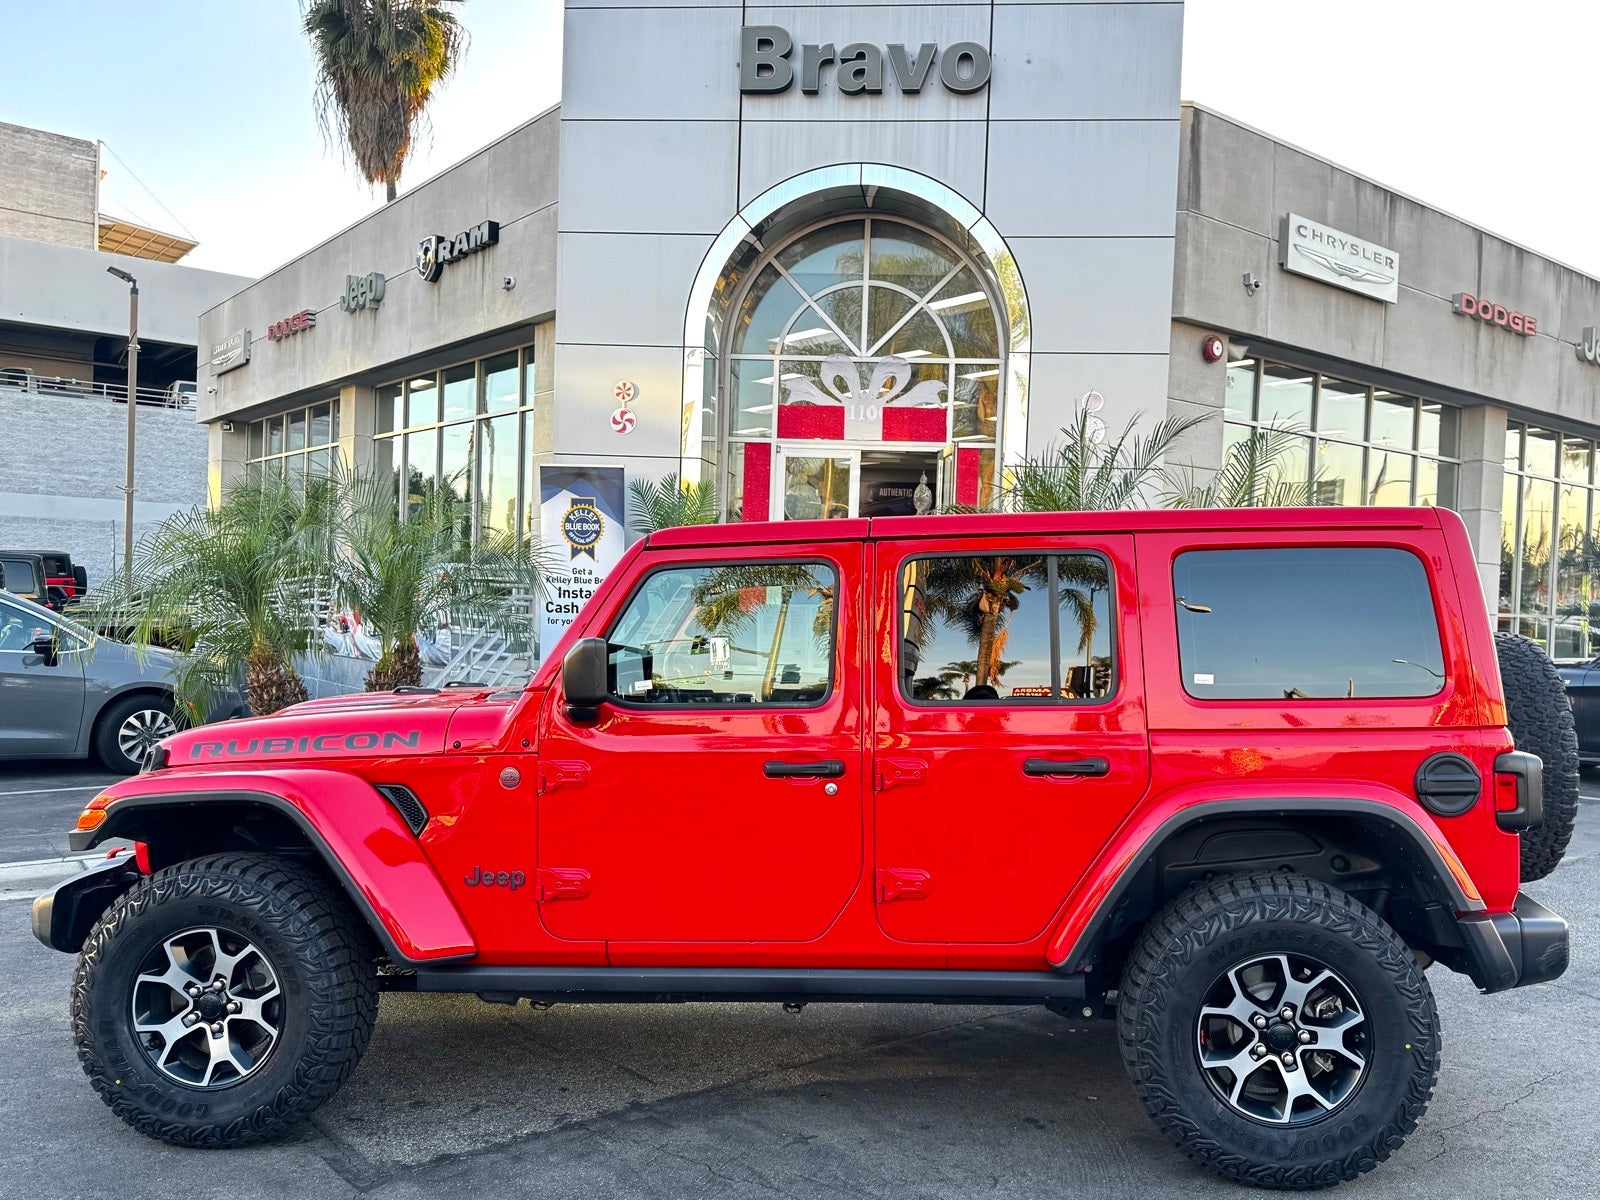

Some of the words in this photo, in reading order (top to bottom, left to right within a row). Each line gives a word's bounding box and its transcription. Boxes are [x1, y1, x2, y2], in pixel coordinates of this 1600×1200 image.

[739, 25, 992, 95] Bravo
[437, 220, 499, 265] RAM
[1296, 223, 1395, 270] CHRYSLER
[340, 271, 385, 313] Jeep
[1459, 292, 1537, 336] DODGE
[267, 309, 316, 342] DODGE
[848, 404, 883, 421] 110
[879, 487, 913, 497] AUTHENTIC
[568, 509, 598, 521] KELLEY
[565, 523, 582, 531] BLUE
[583, 523, 600, 531] BOOK
[572, 567, 586, 575] Get
[546, 575, 572, 585] Kelley
[573, 576, 592, 584] Blue
[558, 586, 596, 599] Insta
[545, 601, 579, 614] Cash
[547, 617, 560, 625] for
[561, 618, 573, 626] yo
[189, 731, 421, 759] RUBICON
[464, 866, 526, 891] Jeep
